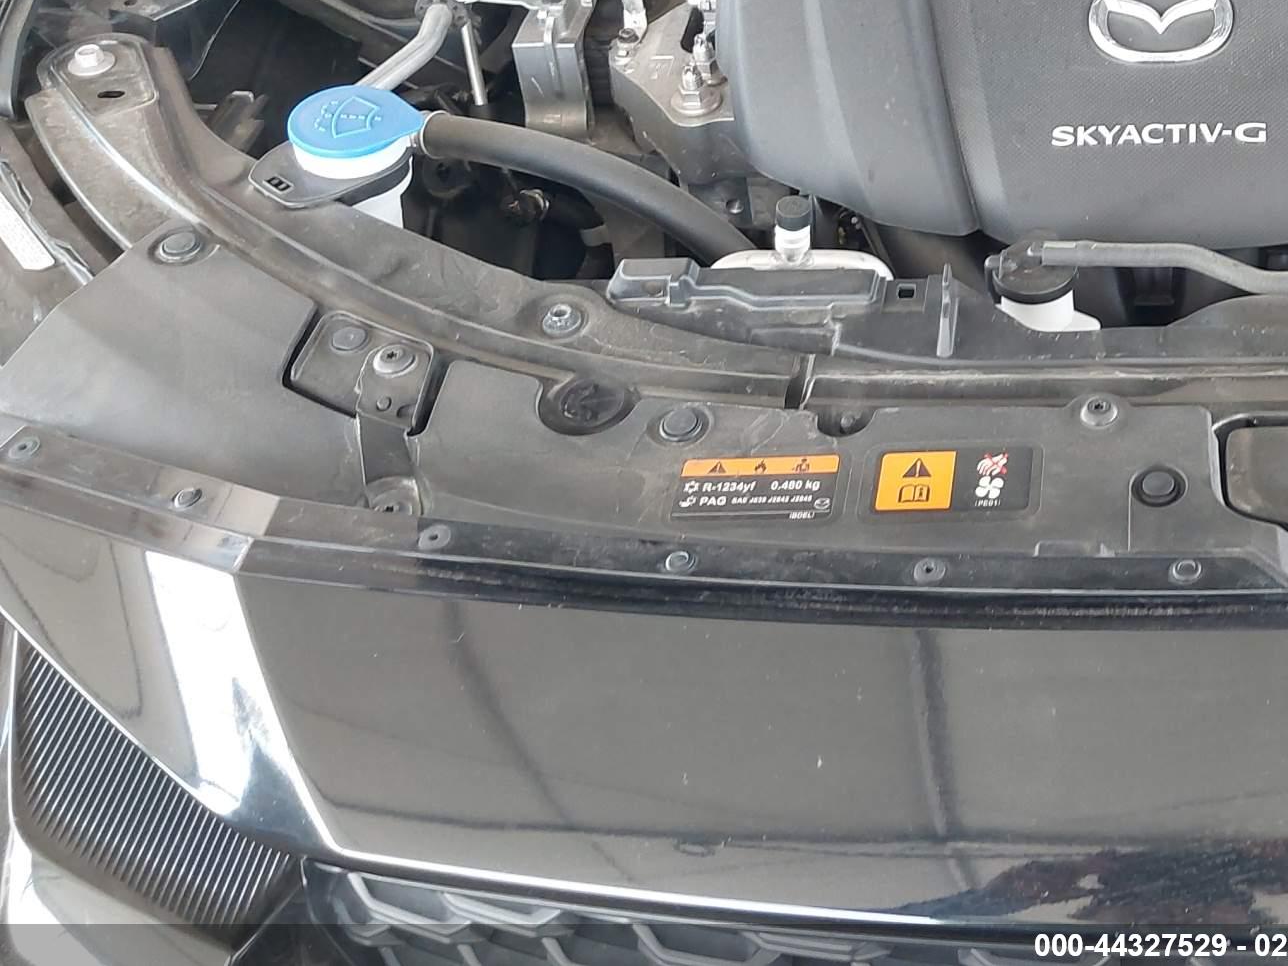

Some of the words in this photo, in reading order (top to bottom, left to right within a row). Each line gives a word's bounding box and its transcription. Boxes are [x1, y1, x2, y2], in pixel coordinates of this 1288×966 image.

[1051, 122, 1267, 147] SKYACTIV-G
[702, 480, 757, 494] R-1234yf
[805, 479, 821, 491] kg
[699, 496, 727, 507] PAG
